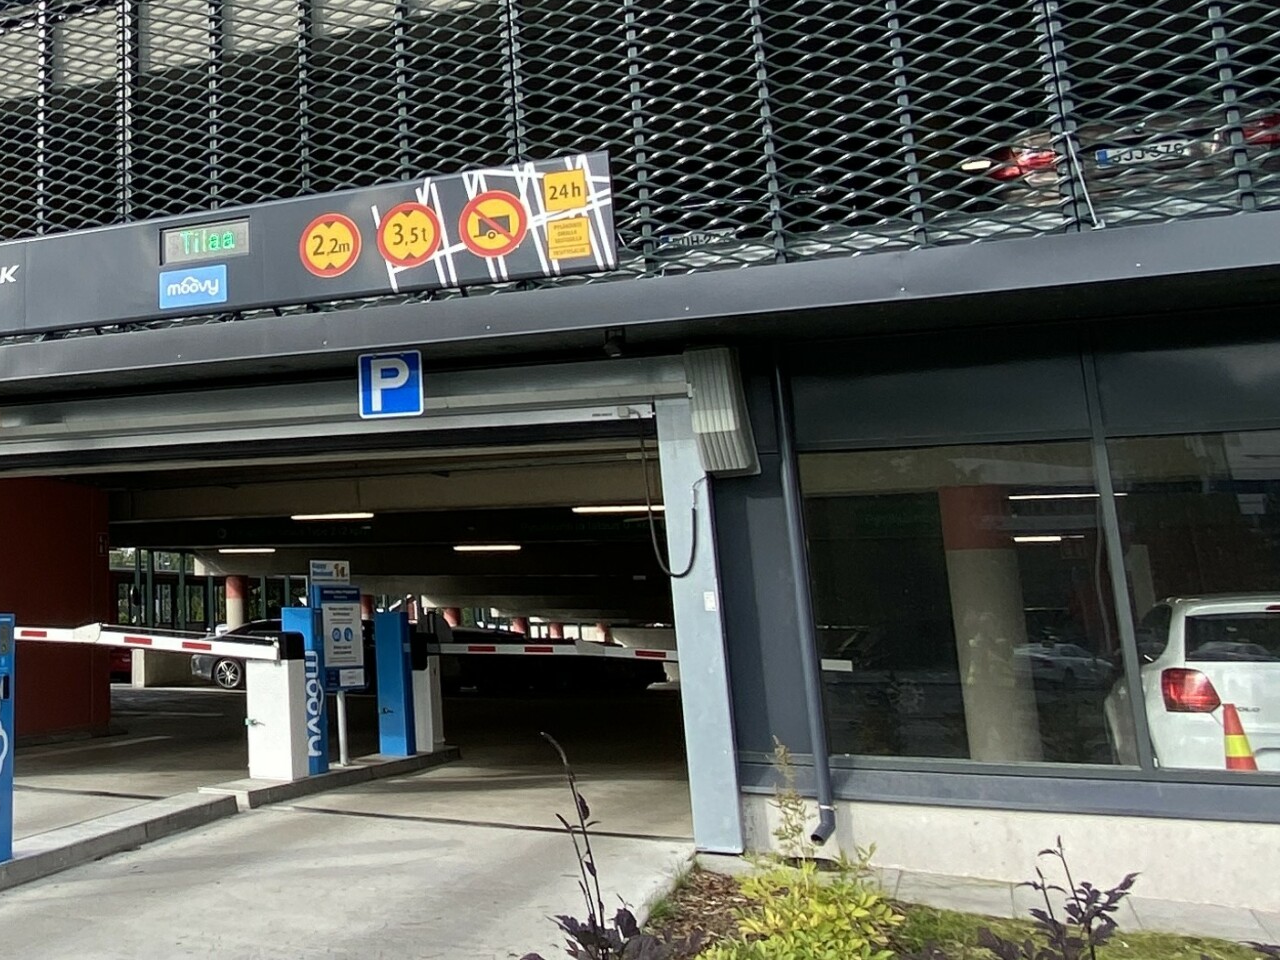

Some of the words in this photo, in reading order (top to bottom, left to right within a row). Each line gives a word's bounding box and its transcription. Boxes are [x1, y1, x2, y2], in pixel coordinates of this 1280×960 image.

[179, 229, 235, 255] Tilaa
[167, 276, 219, 296] moovy
[370, 357, 410, 412] P
